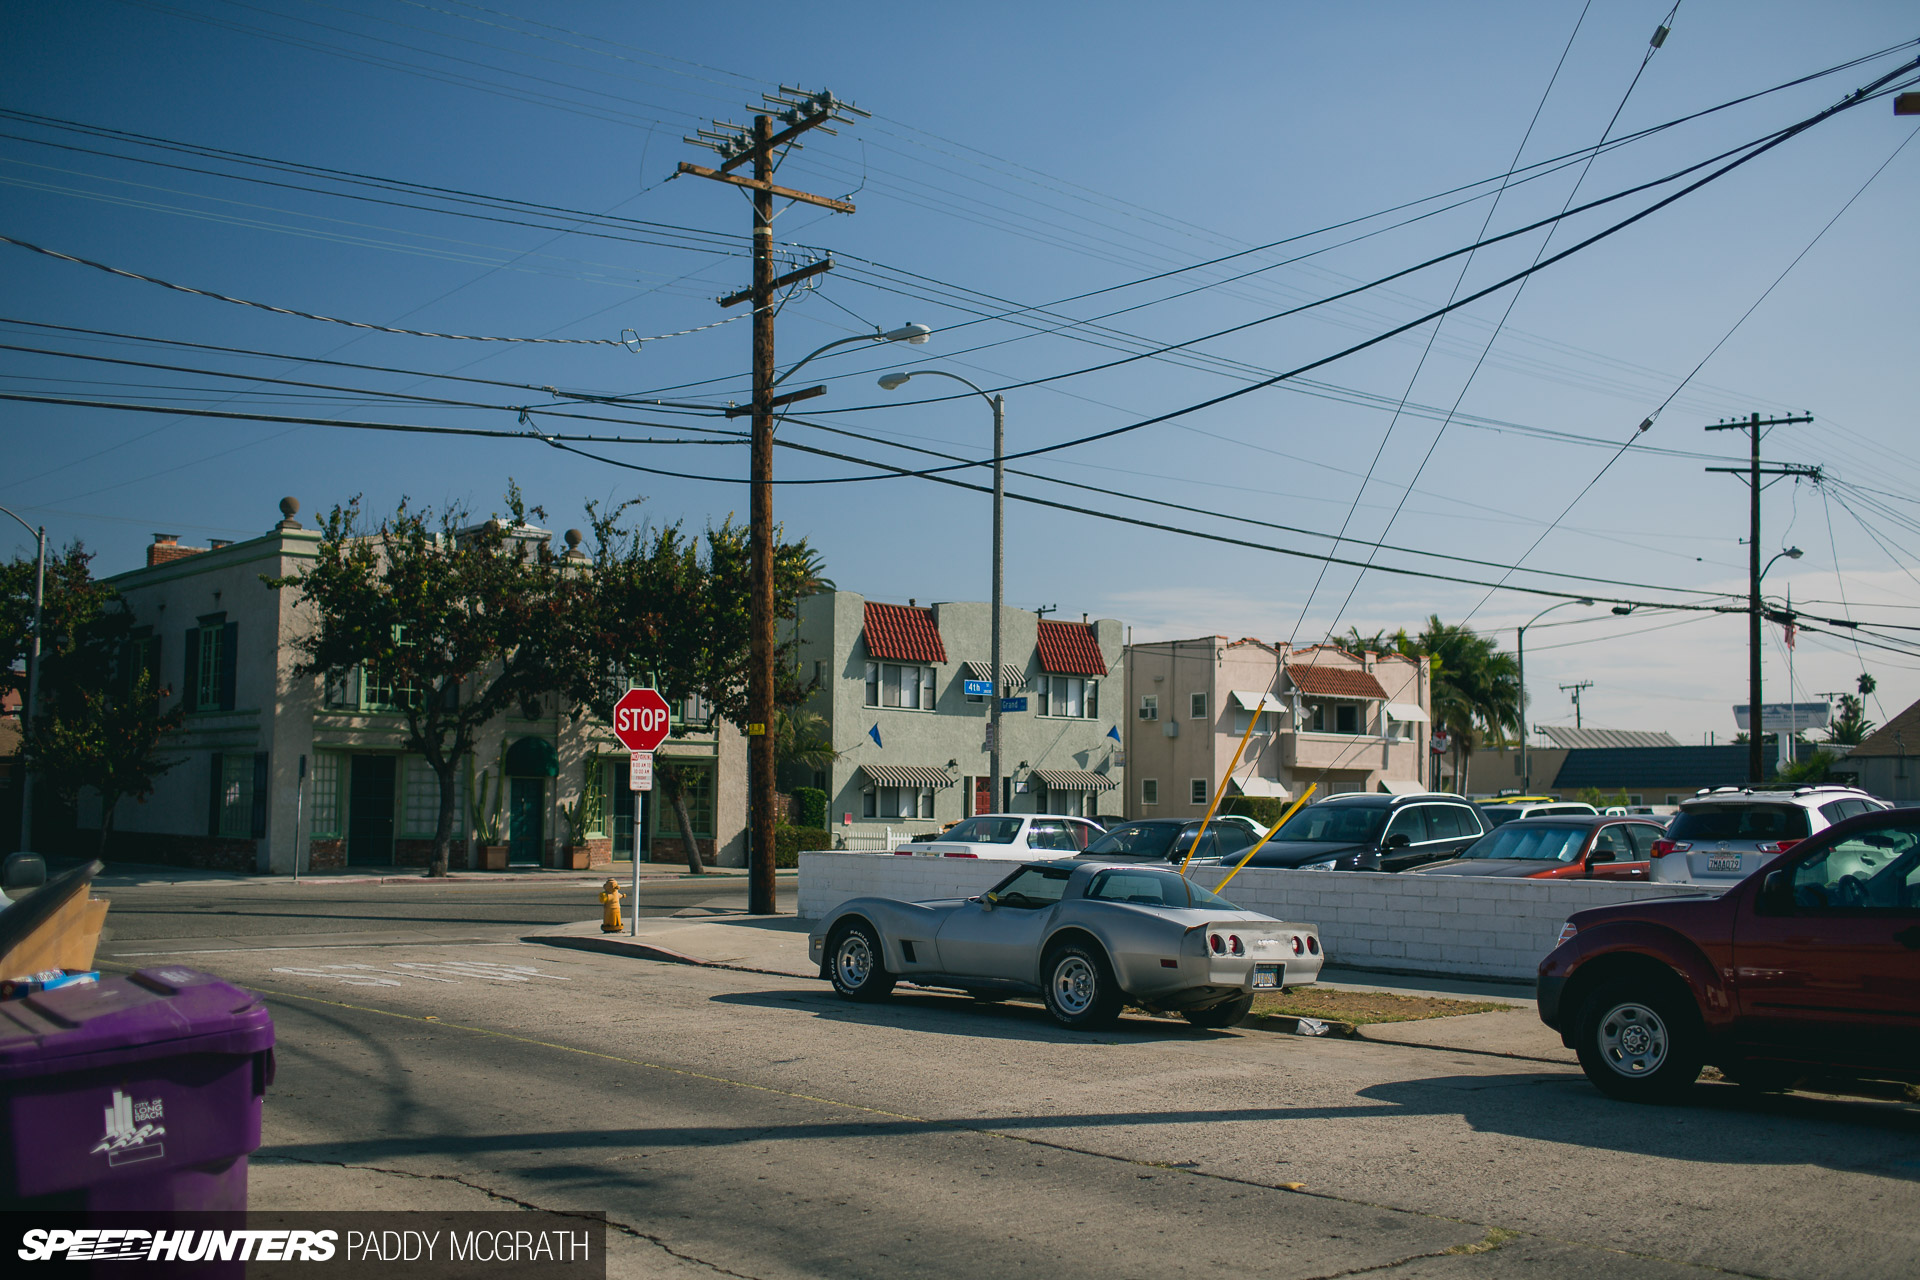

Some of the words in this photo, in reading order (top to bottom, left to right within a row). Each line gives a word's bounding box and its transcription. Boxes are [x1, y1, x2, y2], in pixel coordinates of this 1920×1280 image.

[968, 683, 980, 692] 4th
[1002, 701, 1018, 709] Grand
[618, 708, 666, 732] STOP
[850, 930, 869, 945] RADIAL
[134, 1104, 163, 1115] LONG
[135, 1111, 163, 1122] BEACH
